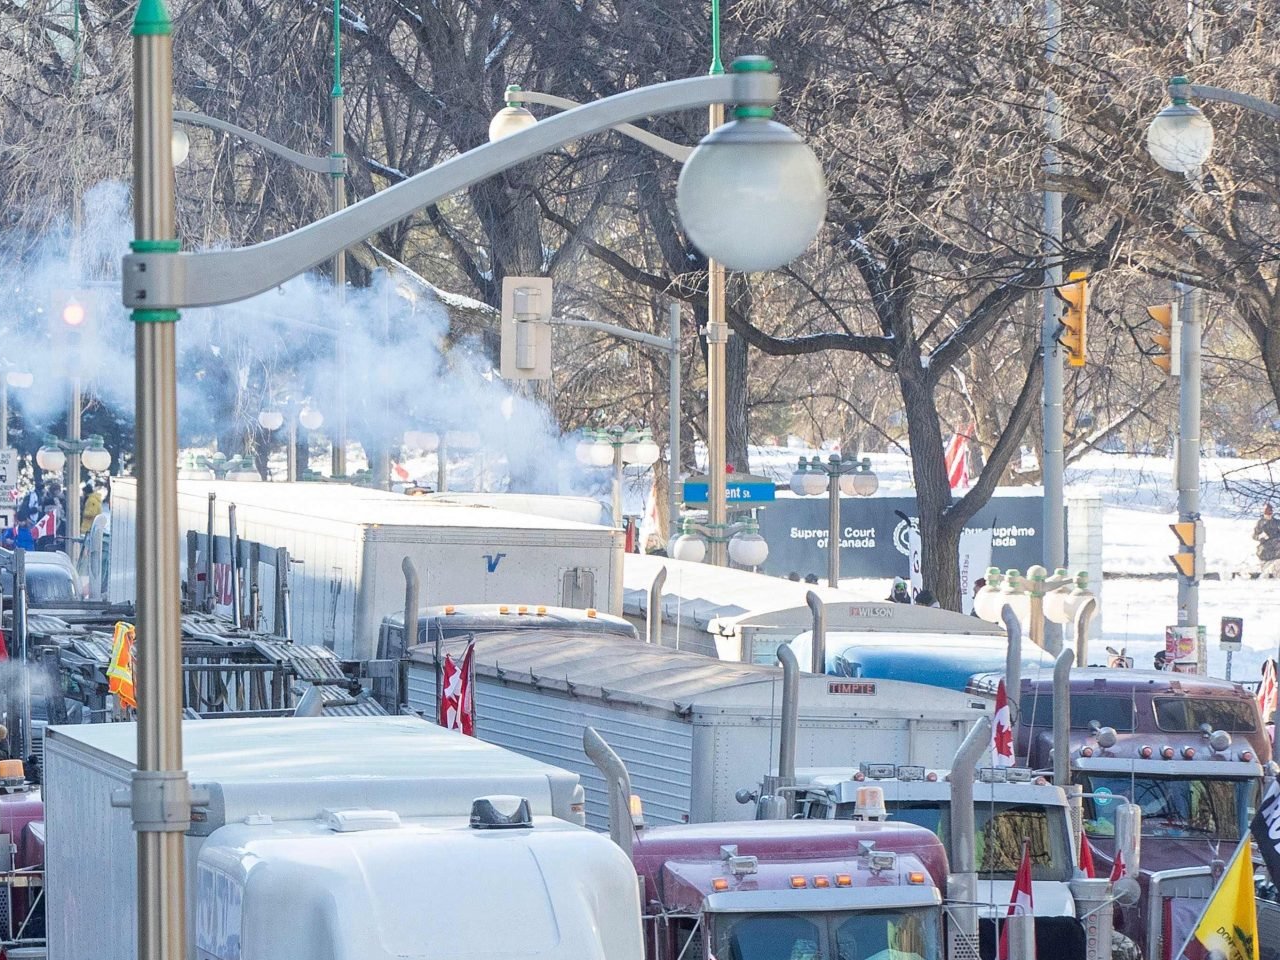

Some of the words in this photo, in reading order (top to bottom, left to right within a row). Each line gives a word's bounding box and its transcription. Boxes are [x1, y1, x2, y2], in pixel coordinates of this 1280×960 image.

[725, 487, 741, 498] ent
[844, 527, 875, 538] Court
[993, 525, 1036, 537] uprême
[861, 607, 893, 617] WILSON
[832, 683, 874, 695] TIMPTE
